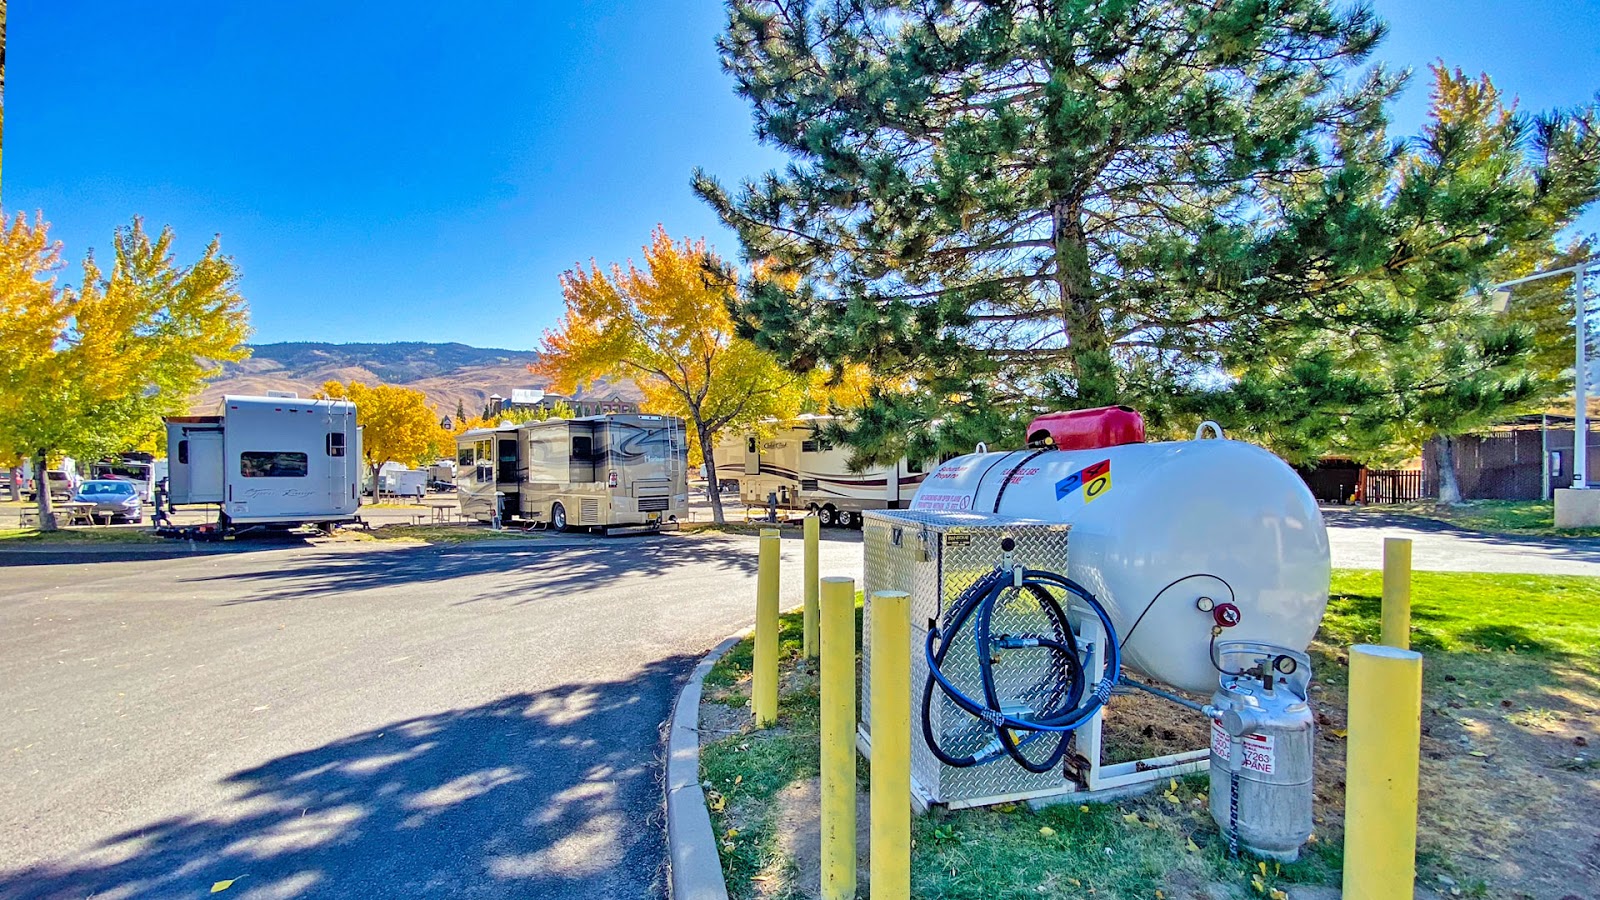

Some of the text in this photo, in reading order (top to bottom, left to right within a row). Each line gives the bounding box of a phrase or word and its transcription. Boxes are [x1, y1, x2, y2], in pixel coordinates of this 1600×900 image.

[933, 472, 959, 480] Propane
[1086, 463, 1105, 477] 4
[1058, 475, 1079, 493] 2
[1247, 751, 1270, 763] 7263
